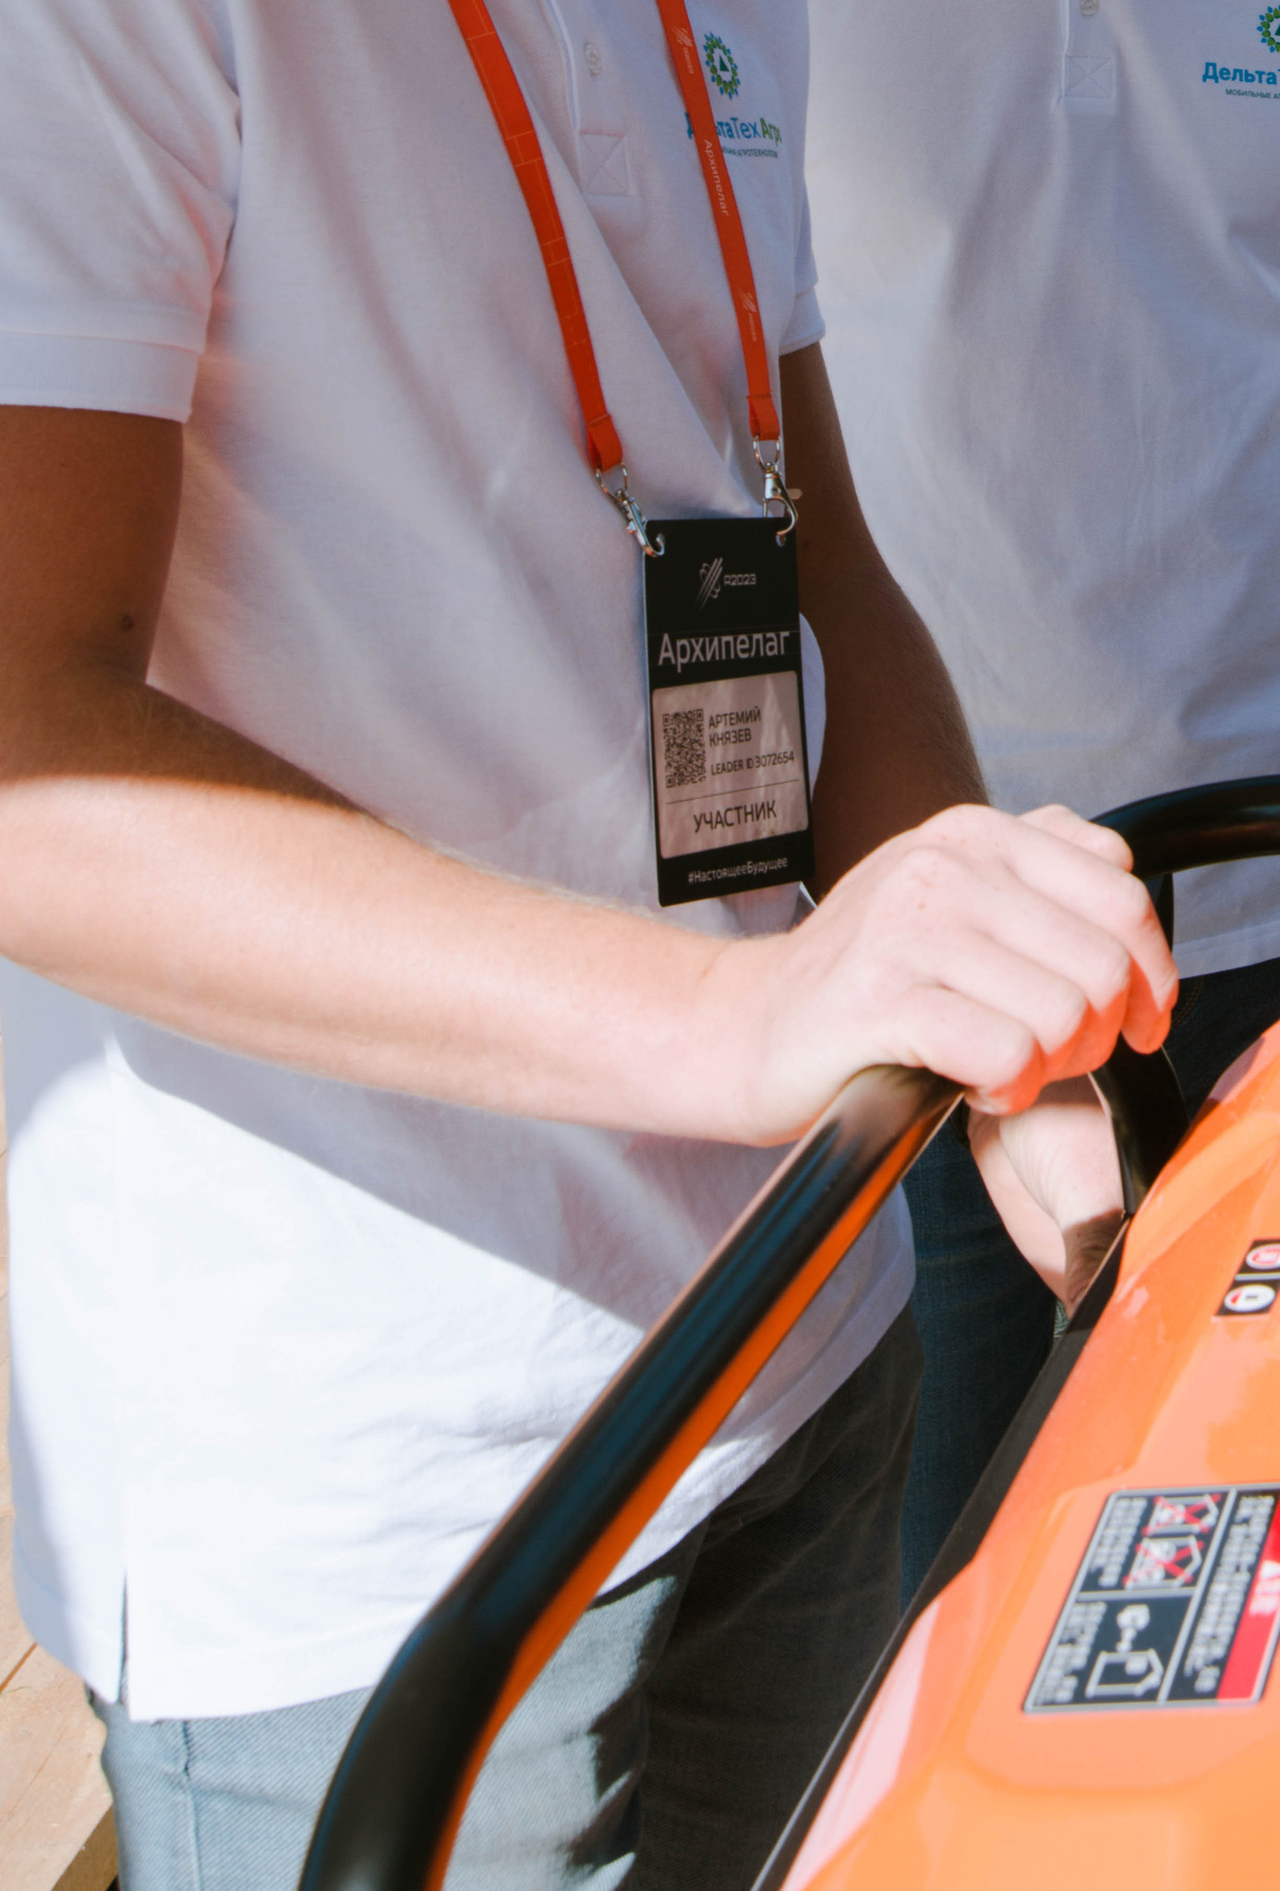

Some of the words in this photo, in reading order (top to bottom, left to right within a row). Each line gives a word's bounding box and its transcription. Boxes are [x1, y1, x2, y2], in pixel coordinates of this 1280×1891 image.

[1225, 88, 1272, 100] МОБИЛЬНЫЕ
[704, 139, 730, 217] Архипелаг
[658, 631, 790, 673] Архипелаг
[708, 706, 762, 729] АРТЕМИЙ
[709, 727, 752, 747] КНЯЗЕВ
[711, 760, 745, 776] LEADER
[755, 751, 795, 769] 3072654
[693, 800, 778, 833] УЧАСТНИК
[687, 857, 789, 885] #НастоящееБудущее
